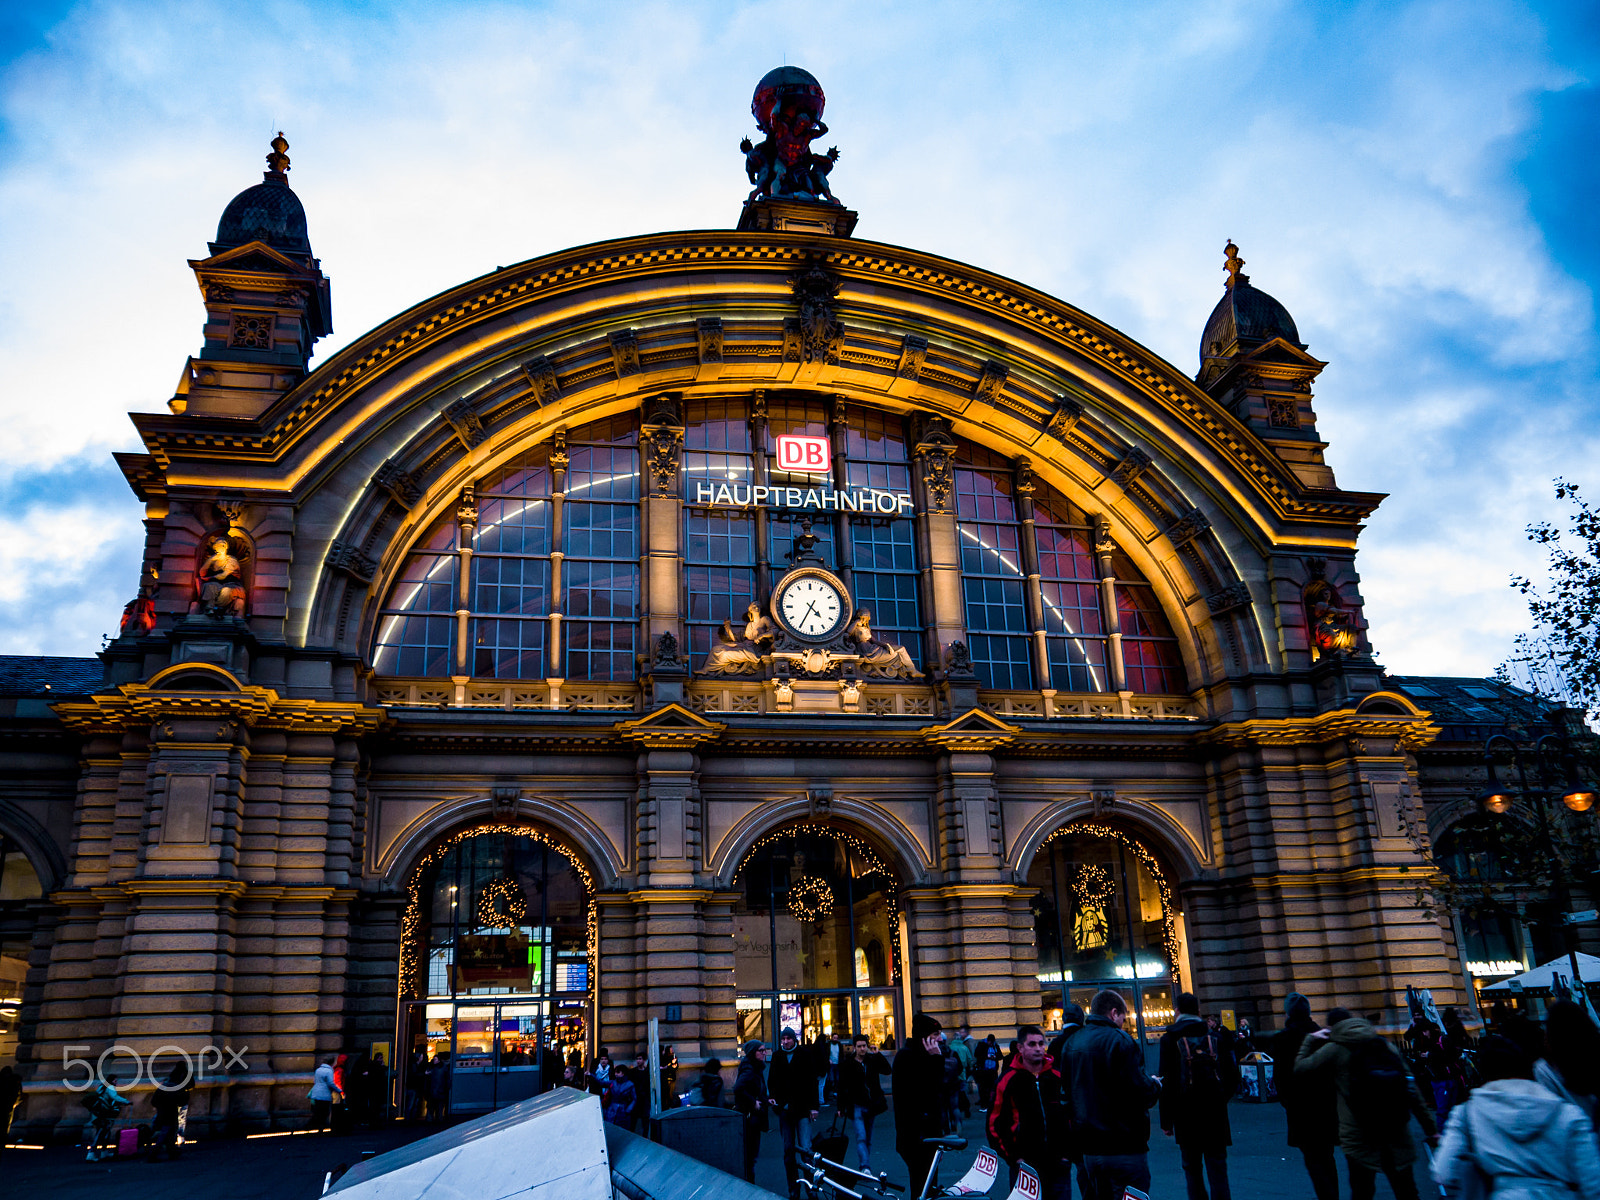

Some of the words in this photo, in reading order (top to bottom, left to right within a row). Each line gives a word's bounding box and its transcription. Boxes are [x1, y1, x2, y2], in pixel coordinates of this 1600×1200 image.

[785, 440, 824, 465] DB
[696, 482, 911, 513] HAUPTBAHNHOF
[750, 940, 798, 954] Vegnsinn
[979, 1154, 994, 1172] DB
[1021, 1173, 1036, 1196] DB
